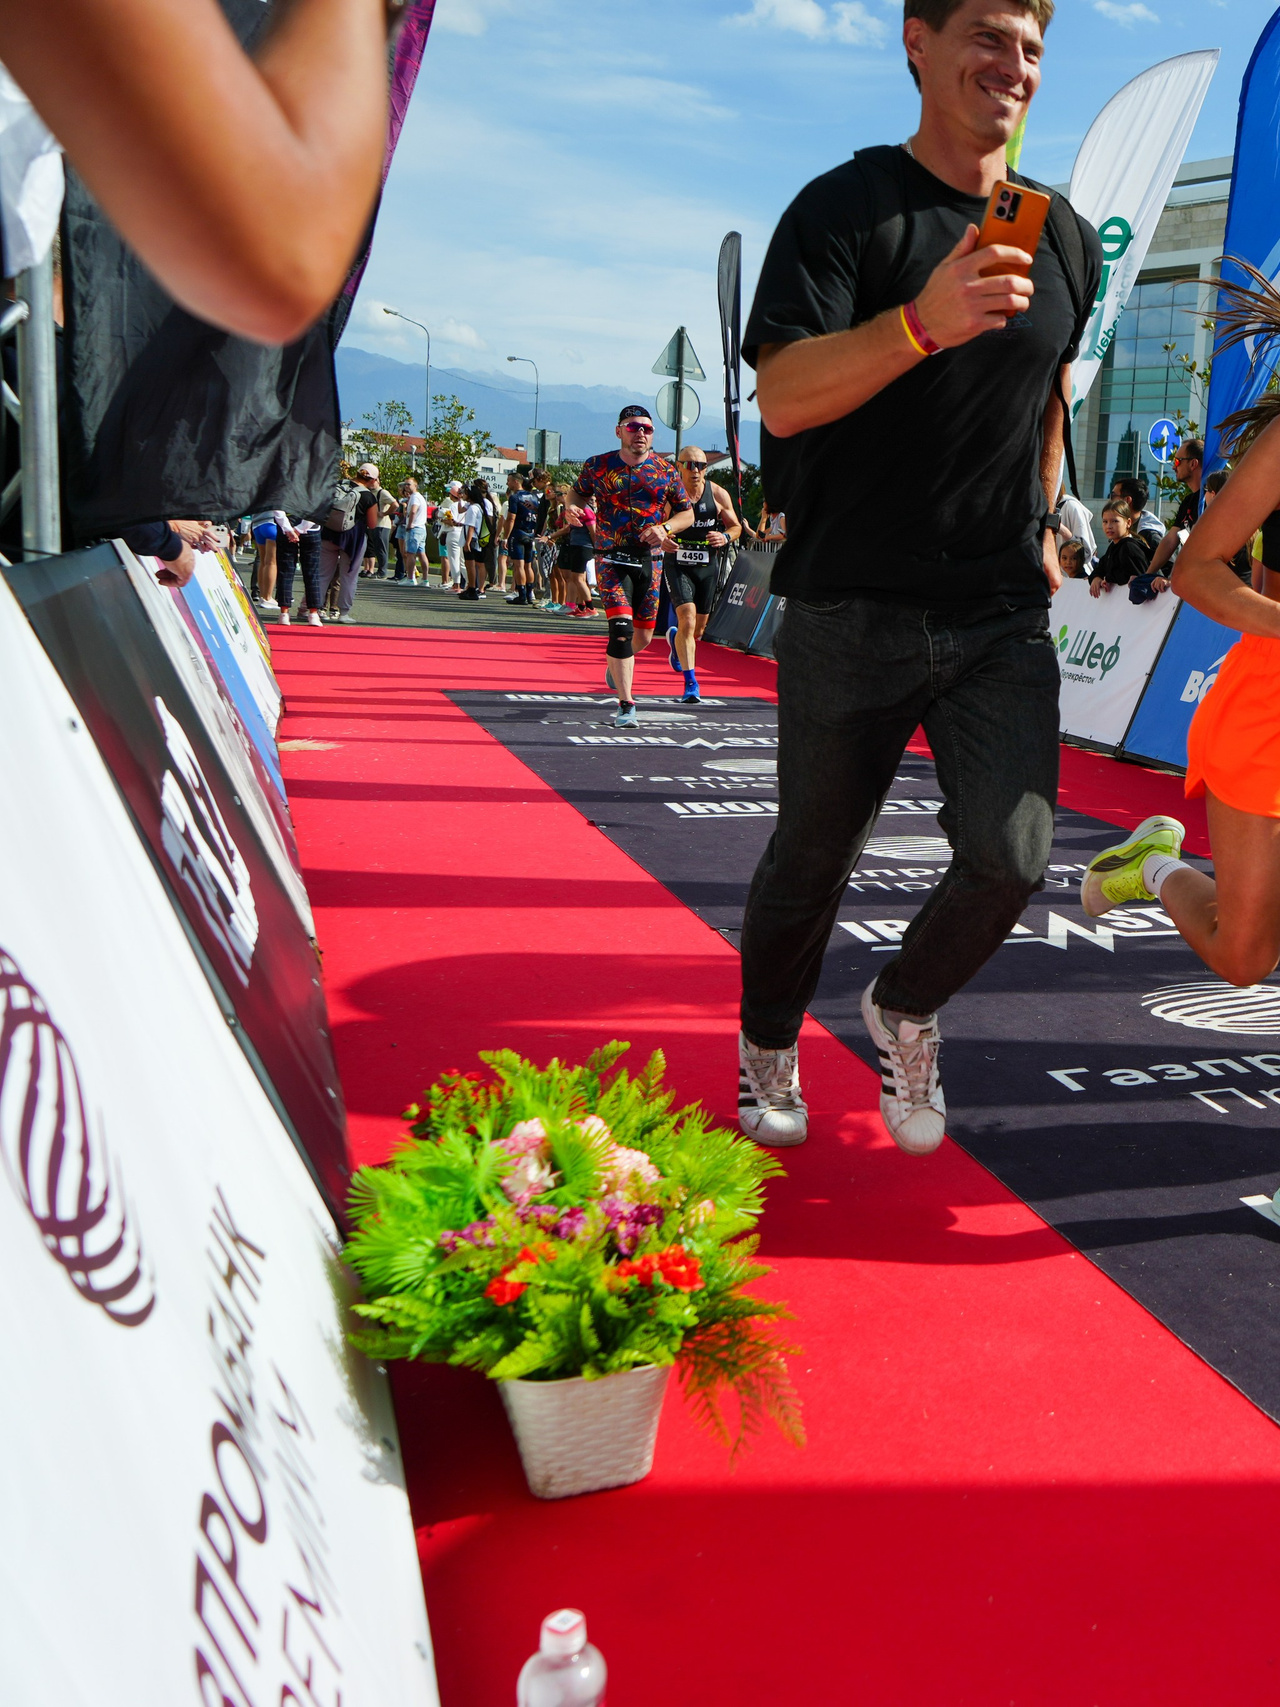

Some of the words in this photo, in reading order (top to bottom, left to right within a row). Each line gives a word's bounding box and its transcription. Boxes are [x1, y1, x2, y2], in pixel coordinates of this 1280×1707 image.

[682, 551, 704, 561] 4450
[1065, 630, 1121, 681] Шеф
[567, 736, 678, 744] IRON
